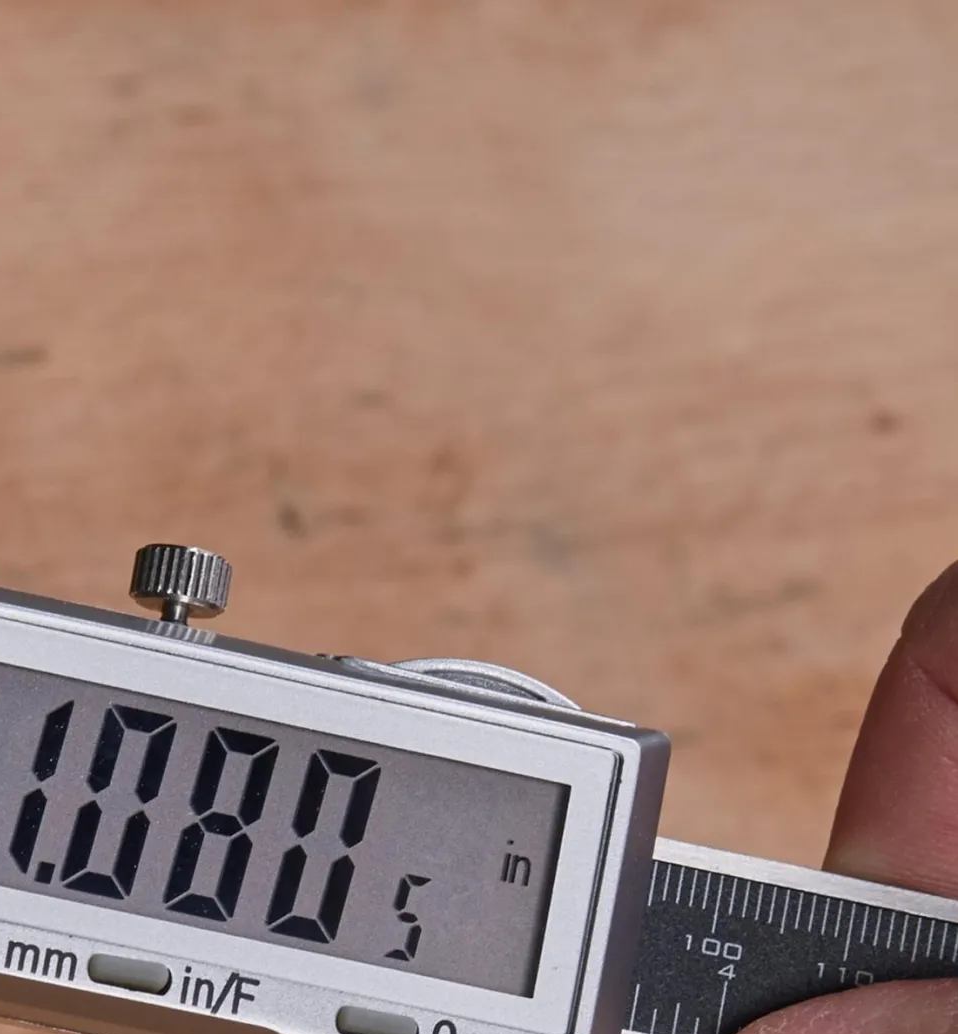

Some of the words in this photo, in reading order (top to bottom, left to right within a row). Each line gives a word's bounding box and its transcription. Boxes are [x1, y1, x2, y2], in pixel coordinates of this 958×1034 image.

[500, 840, 532, 887] in
[4, 938, 78, 981] mm
[685, 933, 743, 960] 100
[180, 964, 262, 1017] in/F
[717, 964, 737, 980] 4
